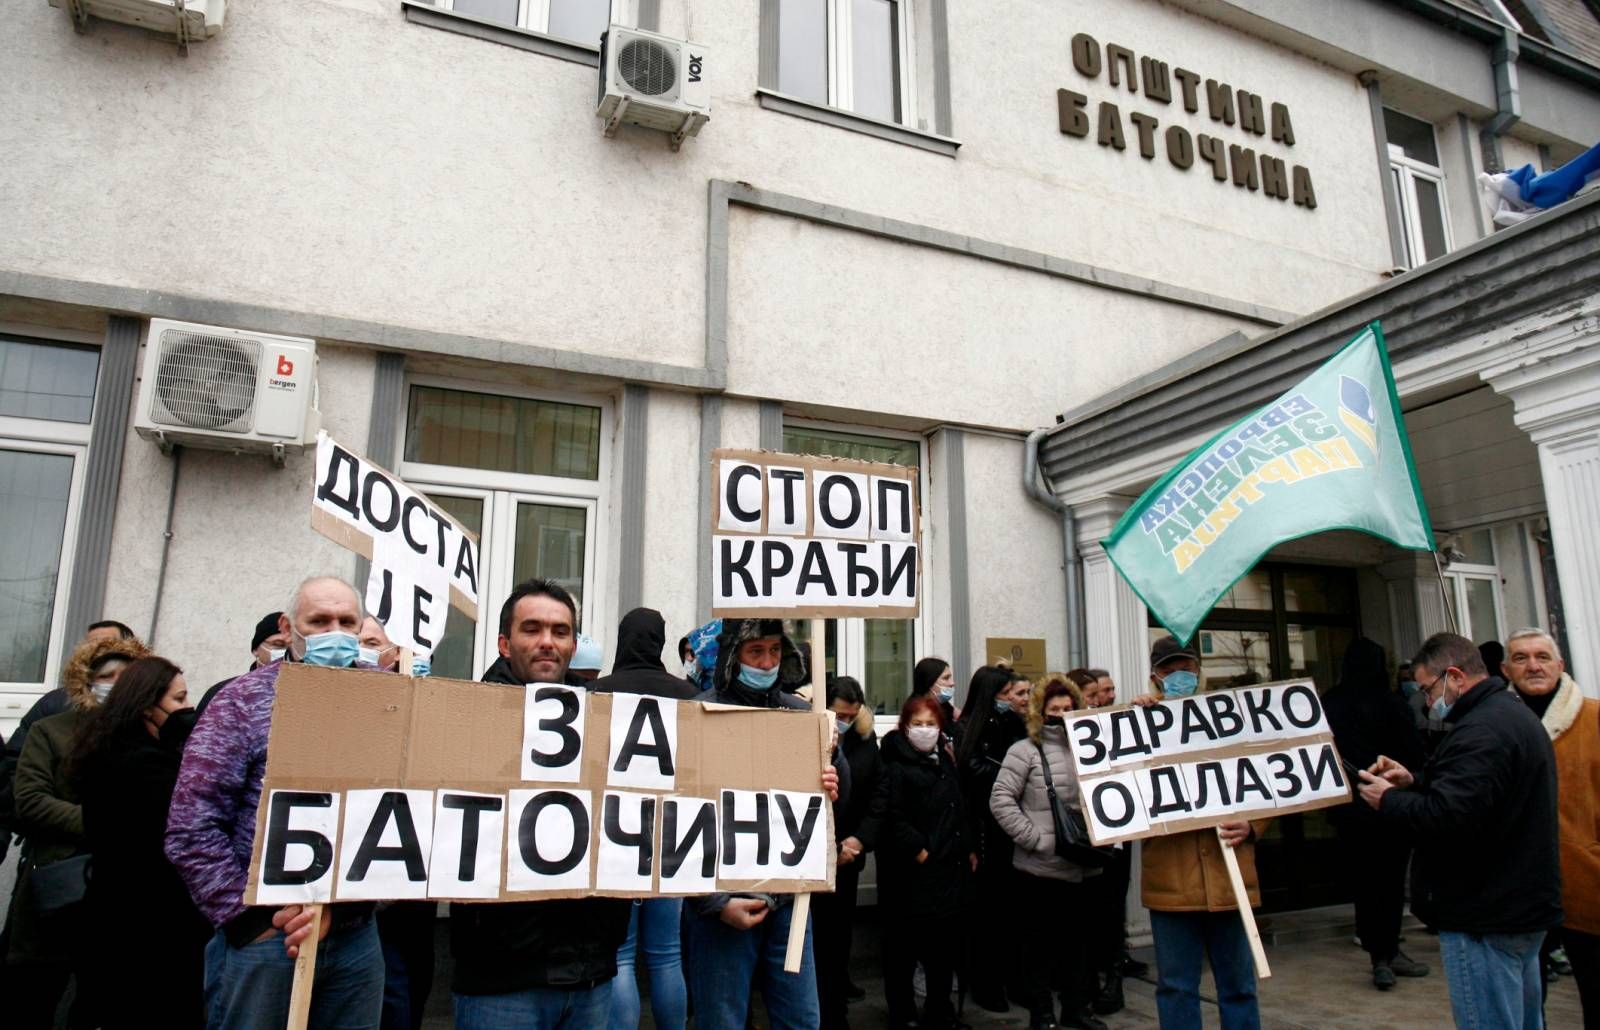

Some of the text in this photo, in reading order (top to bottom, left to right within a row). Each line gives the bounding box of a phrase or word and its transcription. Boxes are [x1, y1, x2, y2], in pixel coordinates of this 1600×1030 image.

[688, 53, 703, 83] VOX
[1071, 33, 1295, 146] ОПШТИНА
[1057, 88, 1317, 209] БАТОЧИНА
[269, 379, 296, 388] bergen
[318, 445, 478, 595] ДОСТА
[726, 465, 910, 533] СТОП
[378, 569, 432, 648] ЈЕ
[721, 539, 916, 597] КРАЂИ
[530, 686, 675, 776] ЗА
[1073, 685, 1321, 765] ЗДРАВКО
[1091, 744, 1344, 828] ОДЛАЗИ
[262, 790, 823, 886] БАТОЧИНУ
